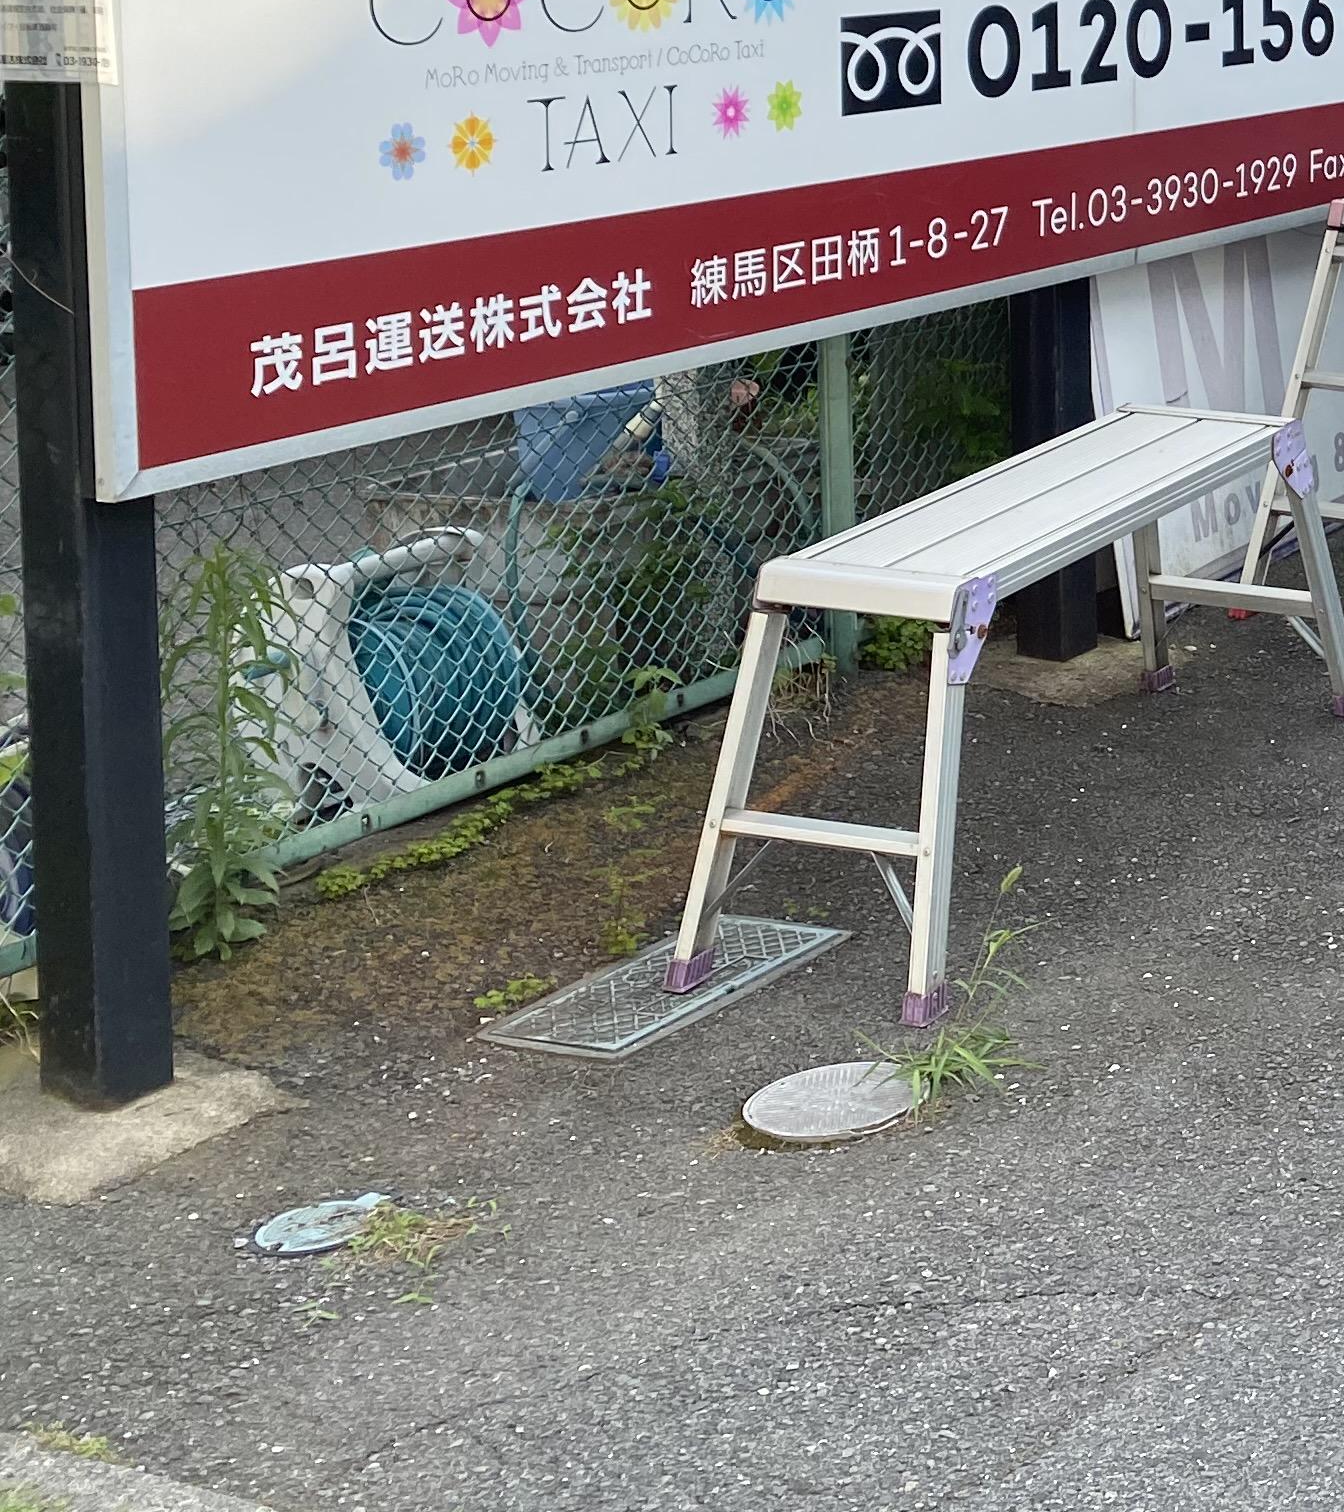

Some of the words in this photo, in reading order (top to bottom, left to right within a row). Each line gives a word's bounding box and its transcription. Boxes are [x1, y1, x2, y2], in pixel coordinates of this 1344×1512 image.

[425, 65, 480, 90] MoRo
[485, 60, 549, 84] Moving
[553, 56, 569, 77] &
[574, 50, 653, 78] Transport
[667, 44, 730, 67] CoCoRo
[735, 39, 766, 59] Taxi
[527, 84, 679, 172] TAXI
[249, 267, 653, 398] 茂呂運送株式会社
[690, 205, 1010, 308] 練馬区田柄1-8-27
